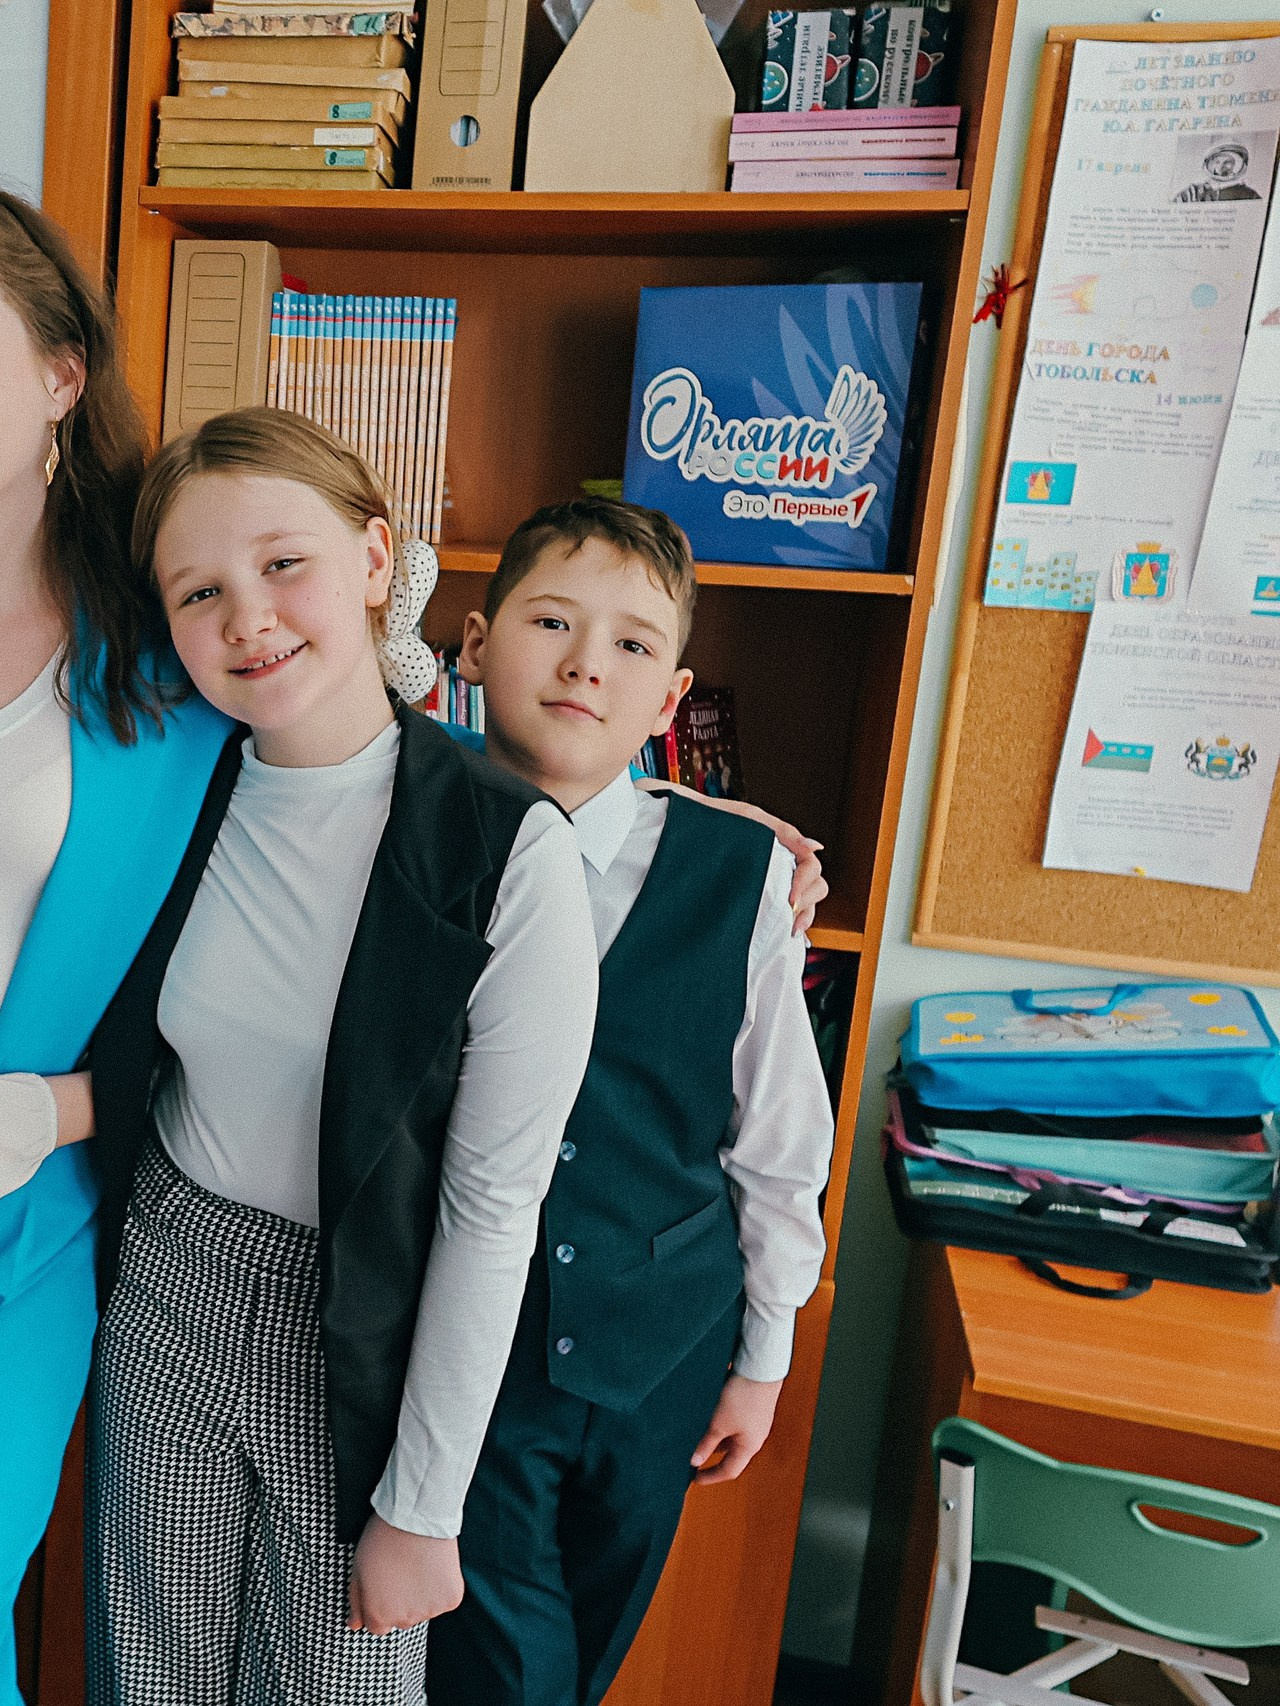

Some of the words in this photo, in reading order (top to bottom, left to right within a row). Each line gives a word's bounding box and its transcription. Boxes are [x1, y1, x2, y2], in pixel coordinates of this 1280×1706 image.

[1135, 56, 1170, 70] ЛЕТ
[1173, 50, 1256, 69] ЗВАНИЮ
[1073, 97, 1192, 114] ГРАЖДАНИНА
[1143, 114, 1243, 132] ГАГАРИНА
[1031, 338, 1083, 357] ДЕНЬ
[1086, 341, 1171, 361] ГОРОДА
[1035, 362, 1157, 384] ТОБОЛЬСКА
[646, 374, 841, 465] Орлята
[728, 495, 765, 514] Это
[773, 498, 849, 520] Первые
